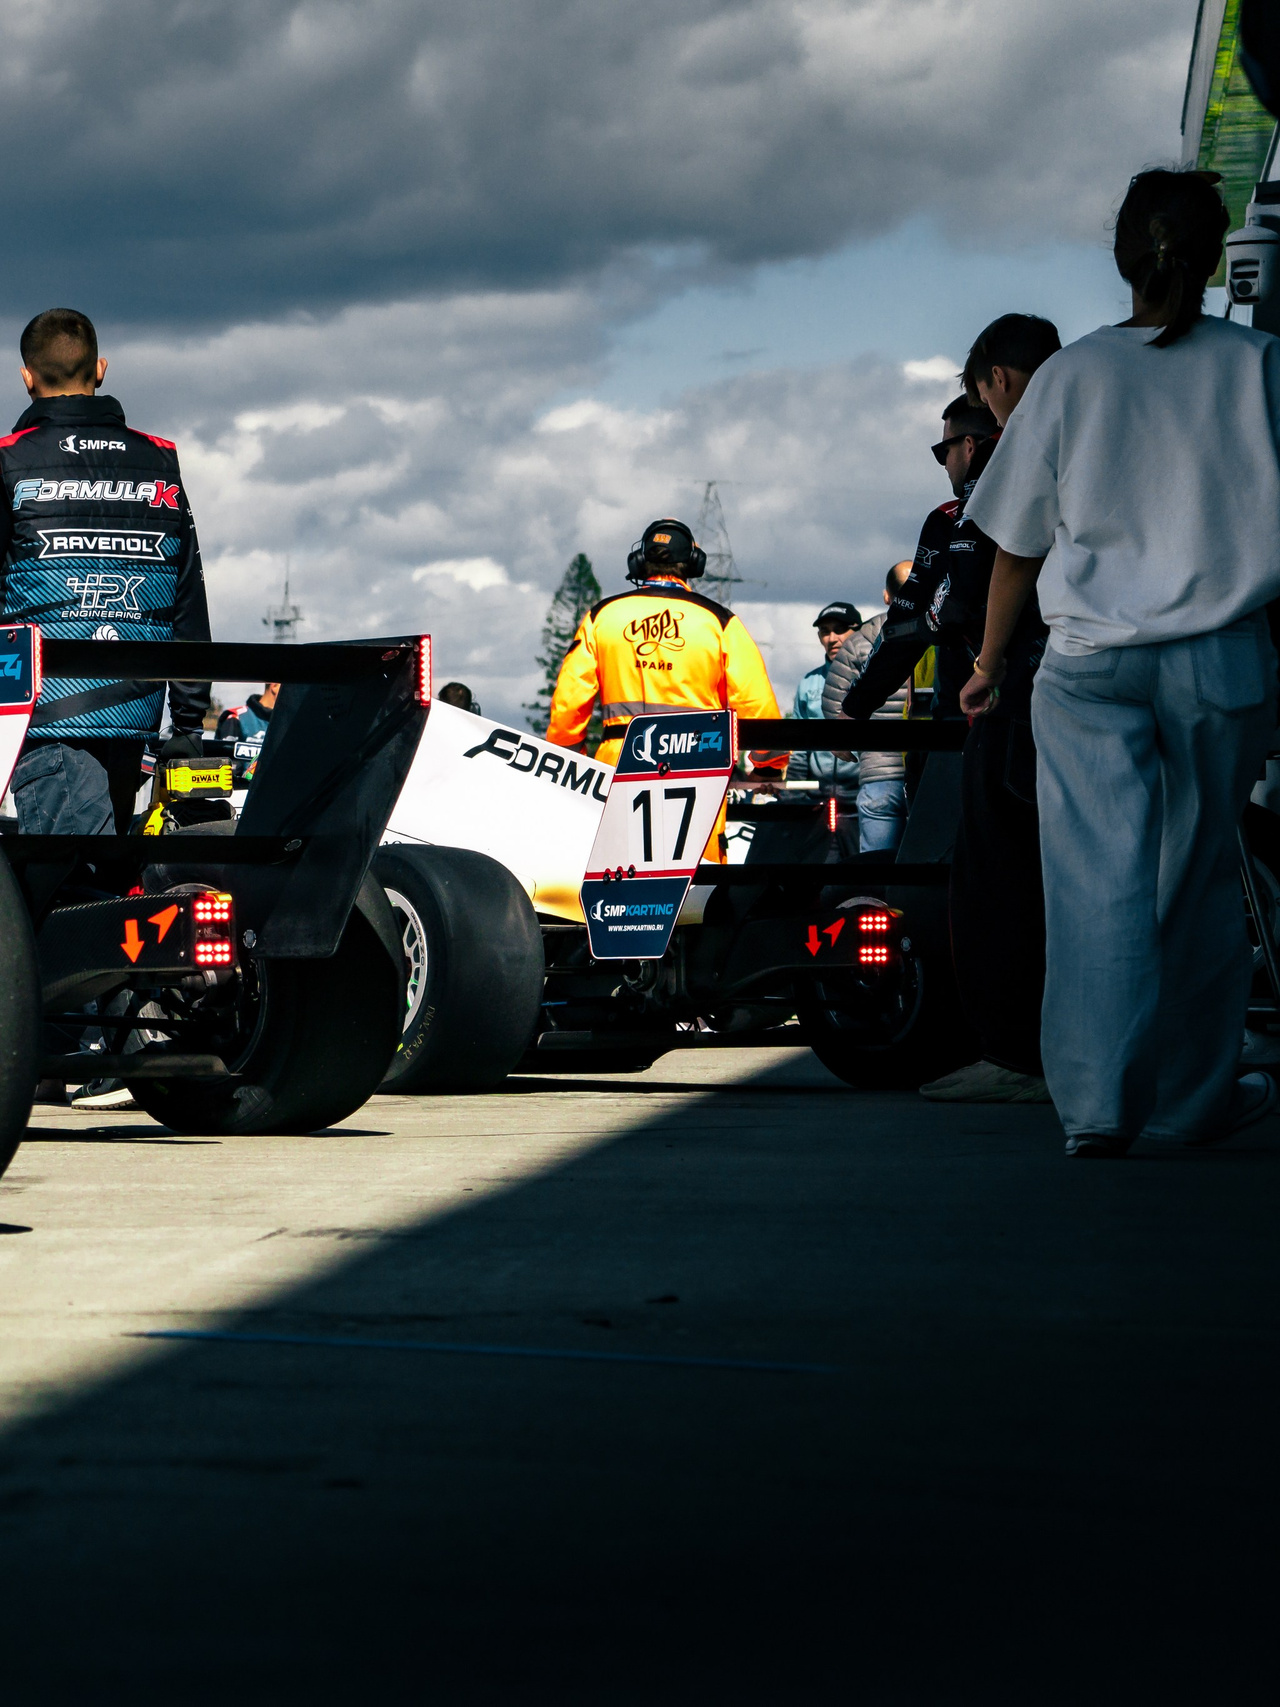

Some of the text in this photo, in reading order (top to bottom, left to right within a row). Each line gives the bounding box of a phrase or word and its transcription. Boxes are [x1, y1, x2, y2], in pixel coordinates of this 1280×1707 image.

[53, 536, 153, 551] RAVENOL
[61, 610, 142, 620] ENGINEERING
[636, 660, 673, 671] ДРАЙВ
[632, 786, 697, 863] 17
[608, 924, 664, 932] WWW.SMPKARTING.RU
